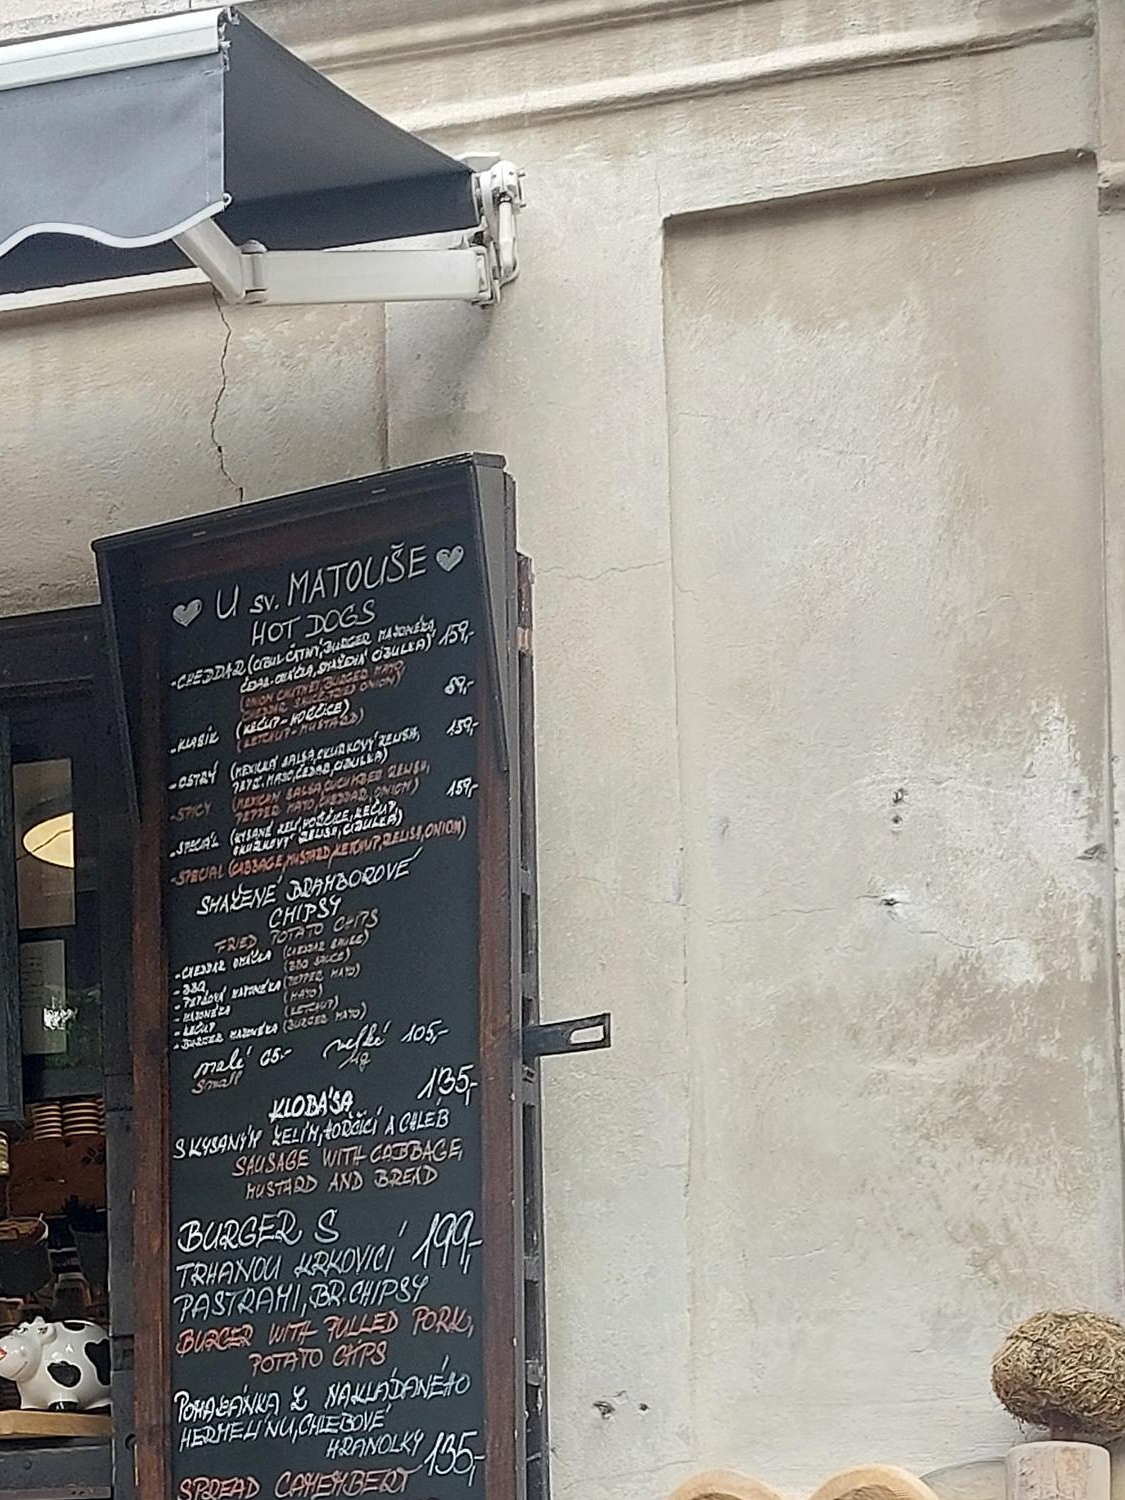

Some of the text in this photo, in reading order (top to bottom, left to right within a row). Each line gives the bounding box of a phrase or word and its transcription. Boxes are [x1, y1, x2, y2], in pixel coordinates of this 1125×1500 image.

[288, 542, 428, 606] MATOUŠE
[252, 600, 376, 647] HOT DOGS
[268, 895, 342, 929] CHIPSY
[215, 908, 380, 954] FRIED POTATO CHIPS
[232, 1146, 367, 1177] SAUSAGE WITH
[245, 1165, 438, 1199] MUSTARD AND BREAD
[177, 1209, 339, 1253] BURGER S
[348, 1276, 428, 1306] CHIPSY
[176, 1324, 254, 1355] BURGER
[268, 1320, 319, 1345] WITH
[323, 1310, 399, 1343] PULLED
[249, 1348, 323, 1376] POTATO
[274, 1464, 423, 1500] CAMEMBERT
